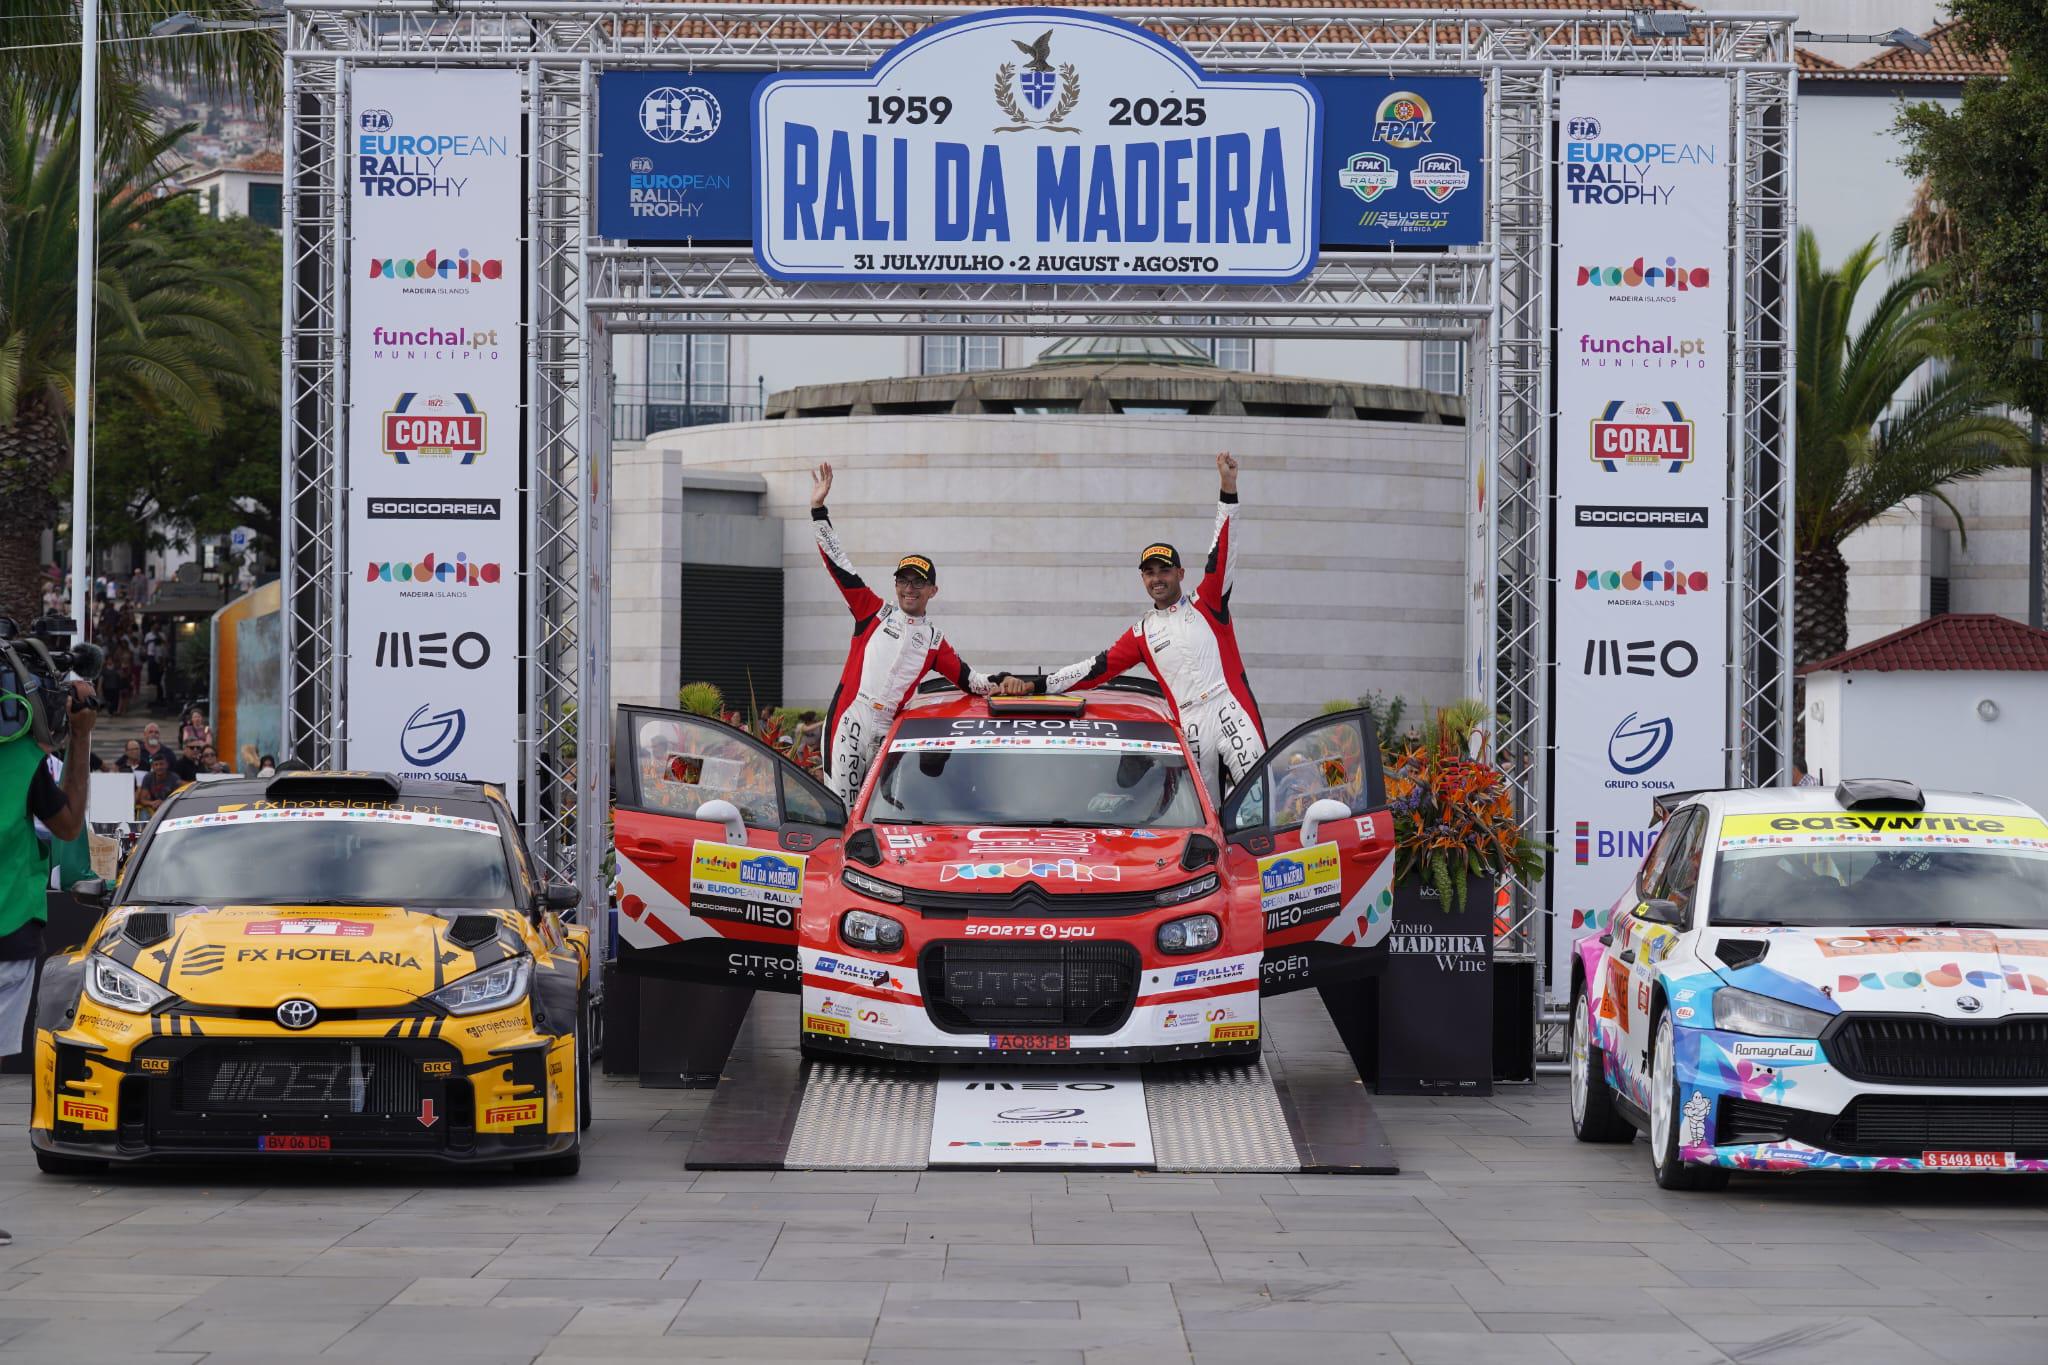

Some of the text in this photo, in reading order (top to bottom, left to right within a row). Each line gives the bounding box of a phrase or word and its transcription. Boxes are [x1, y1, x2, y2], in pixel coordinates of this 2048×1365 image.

[868, 96, 952, 125] 1959
[1108, 97, 1207, 127] 2025
[1373, 121, 1436, 143] FPAK
[360, 134, 508, 156] EUROPEAN
[1567, 142, 1714, 164] EUROPEAN
[360, 155, 442, 176] RALLY
[1356, 161, 1381, 171] FPAK
[1427, 162, 1453, 172] FPAK
[1567, 163, 1650, 184] RALLY
[360, 177, 467, 197] TROPHY
[631, 175, 731, 190] EUROPEAN
[784, 121, 1290, 244] RALI DA MADEIRA
[1350, 177, 1388, 185] RALIS
[631, 189, 687, 203] RALLY
[1567, 184, 1675, 205] TROPHY
[631, 203, 703, 217] TROPHY
[1378, 211, 1449, 220] PEUGEOT
[854, 255, 1219, 274] 31 JULY/JULHO 2 AUGUST AGOSTO
[402, 287, 470, 296] MADEIRA ISLANDS
[373, 326, 498, 350] funchal.pt
[1579, 334, 1705, 358] funchal.pt
[395, 420, 476, 445] CORAL
[1603, 428, 1683, 453] CORAL
[372, 502, 497, 515] SOCICORREIA
[1579, 510, 1704, 523] SOCICORREIA
[1643, 599, 1675, 607] ISLANDS
[375, 631, 491, 669] MEO
[1584, 639, 1699, 678] MEO
[434, 772, 467, 781] SOUSA
[1605, 780, 1675, 790] GRUPO SOUSA
[252, 799, 443, 815] fxhotelaria.pt
[1770, 815, 2006, 834] easywrite
[785, 832, 813, 847] C3
[1251, 836, 1270, 849] C3
[768, 869, 797, 887] MADEIRA
[708, 884, 760, 899] EUROPEAN
[764, 892, 796, 904] RALLY
[1289, 888, 1312, 902] RALLY
[1313, 882, 1340, 896] TROPHY
[746, 903, 792, 926] MEO
[1267, 906, 1302, 931] MEO
[304, 925, 317, 933] 7
[965, 925, 1036, 936] SPORTS
[1389, 936, 1486, 953] MADEIRA
[237, 949, 422, 970] FX HOTELARIA
[1436, 954, 1487, 972] Wine
[837, 962, 886, 977] RALLYE
[840, 970, 858, 979] TEAM
[1198, 963, 1245, 978] RALLYE
[1202, 971, 1243, 983] TEAM SPAIN
[808, 1016, 846, 1034] PIRELLI
[1215, 1025, 1255, 1039] PIRELLI
[1735, 1043, 1814, 1058] RomagnaCavi
[64, 1100, 109, 1123] PIRELLI
[485, 1104, 537, 1125] PIRELLI
[1928, 1153, 2000, 1167] S 5493 BCL
